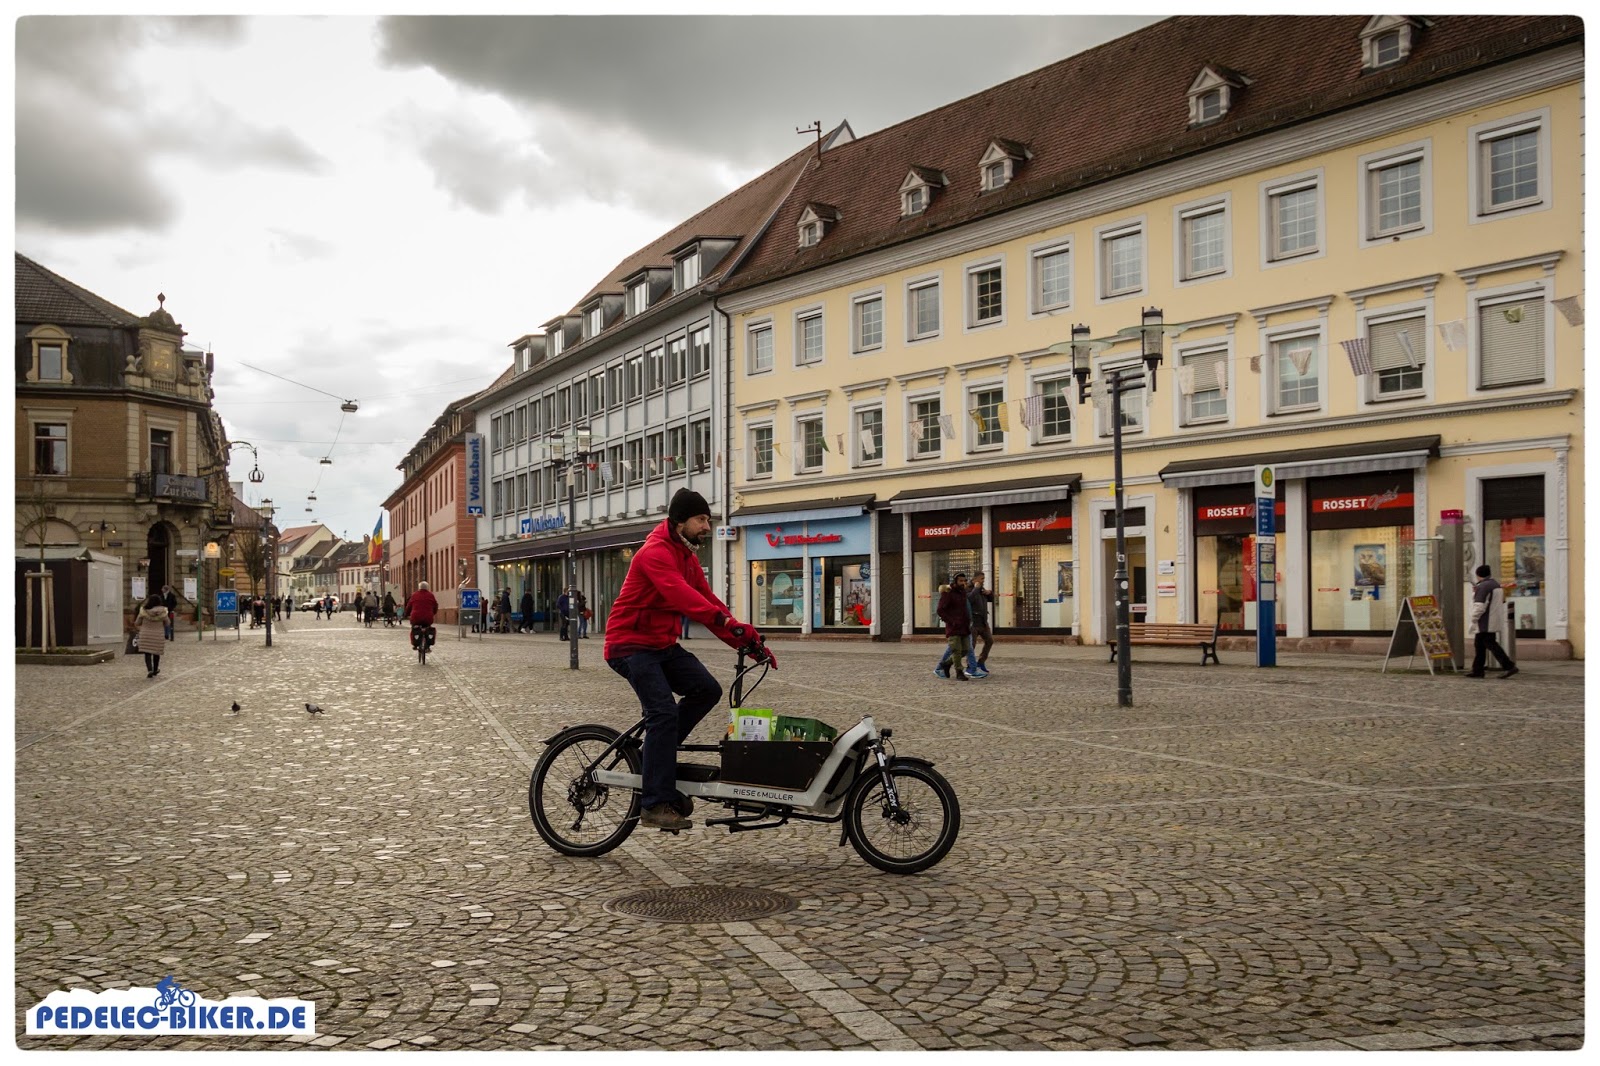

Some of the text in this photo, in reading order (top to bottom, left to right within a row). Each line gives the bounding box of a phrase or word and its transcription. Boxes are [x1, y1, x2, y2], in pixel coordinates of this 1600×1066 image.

[468, 437, 480, 501] Volksbank
[162, 485, 199, 498] Zur Post
[1322, 497, 1367, 510] ROSSET
[1207, 506, 1246, 518] ROSSET
[532, 511, 566, 533] Volksbank
[1006, 520, 1036, 531] ROSSET
[924, 526, 951, 536] ROSSET
[1163, 525, 1170, 534] 4
